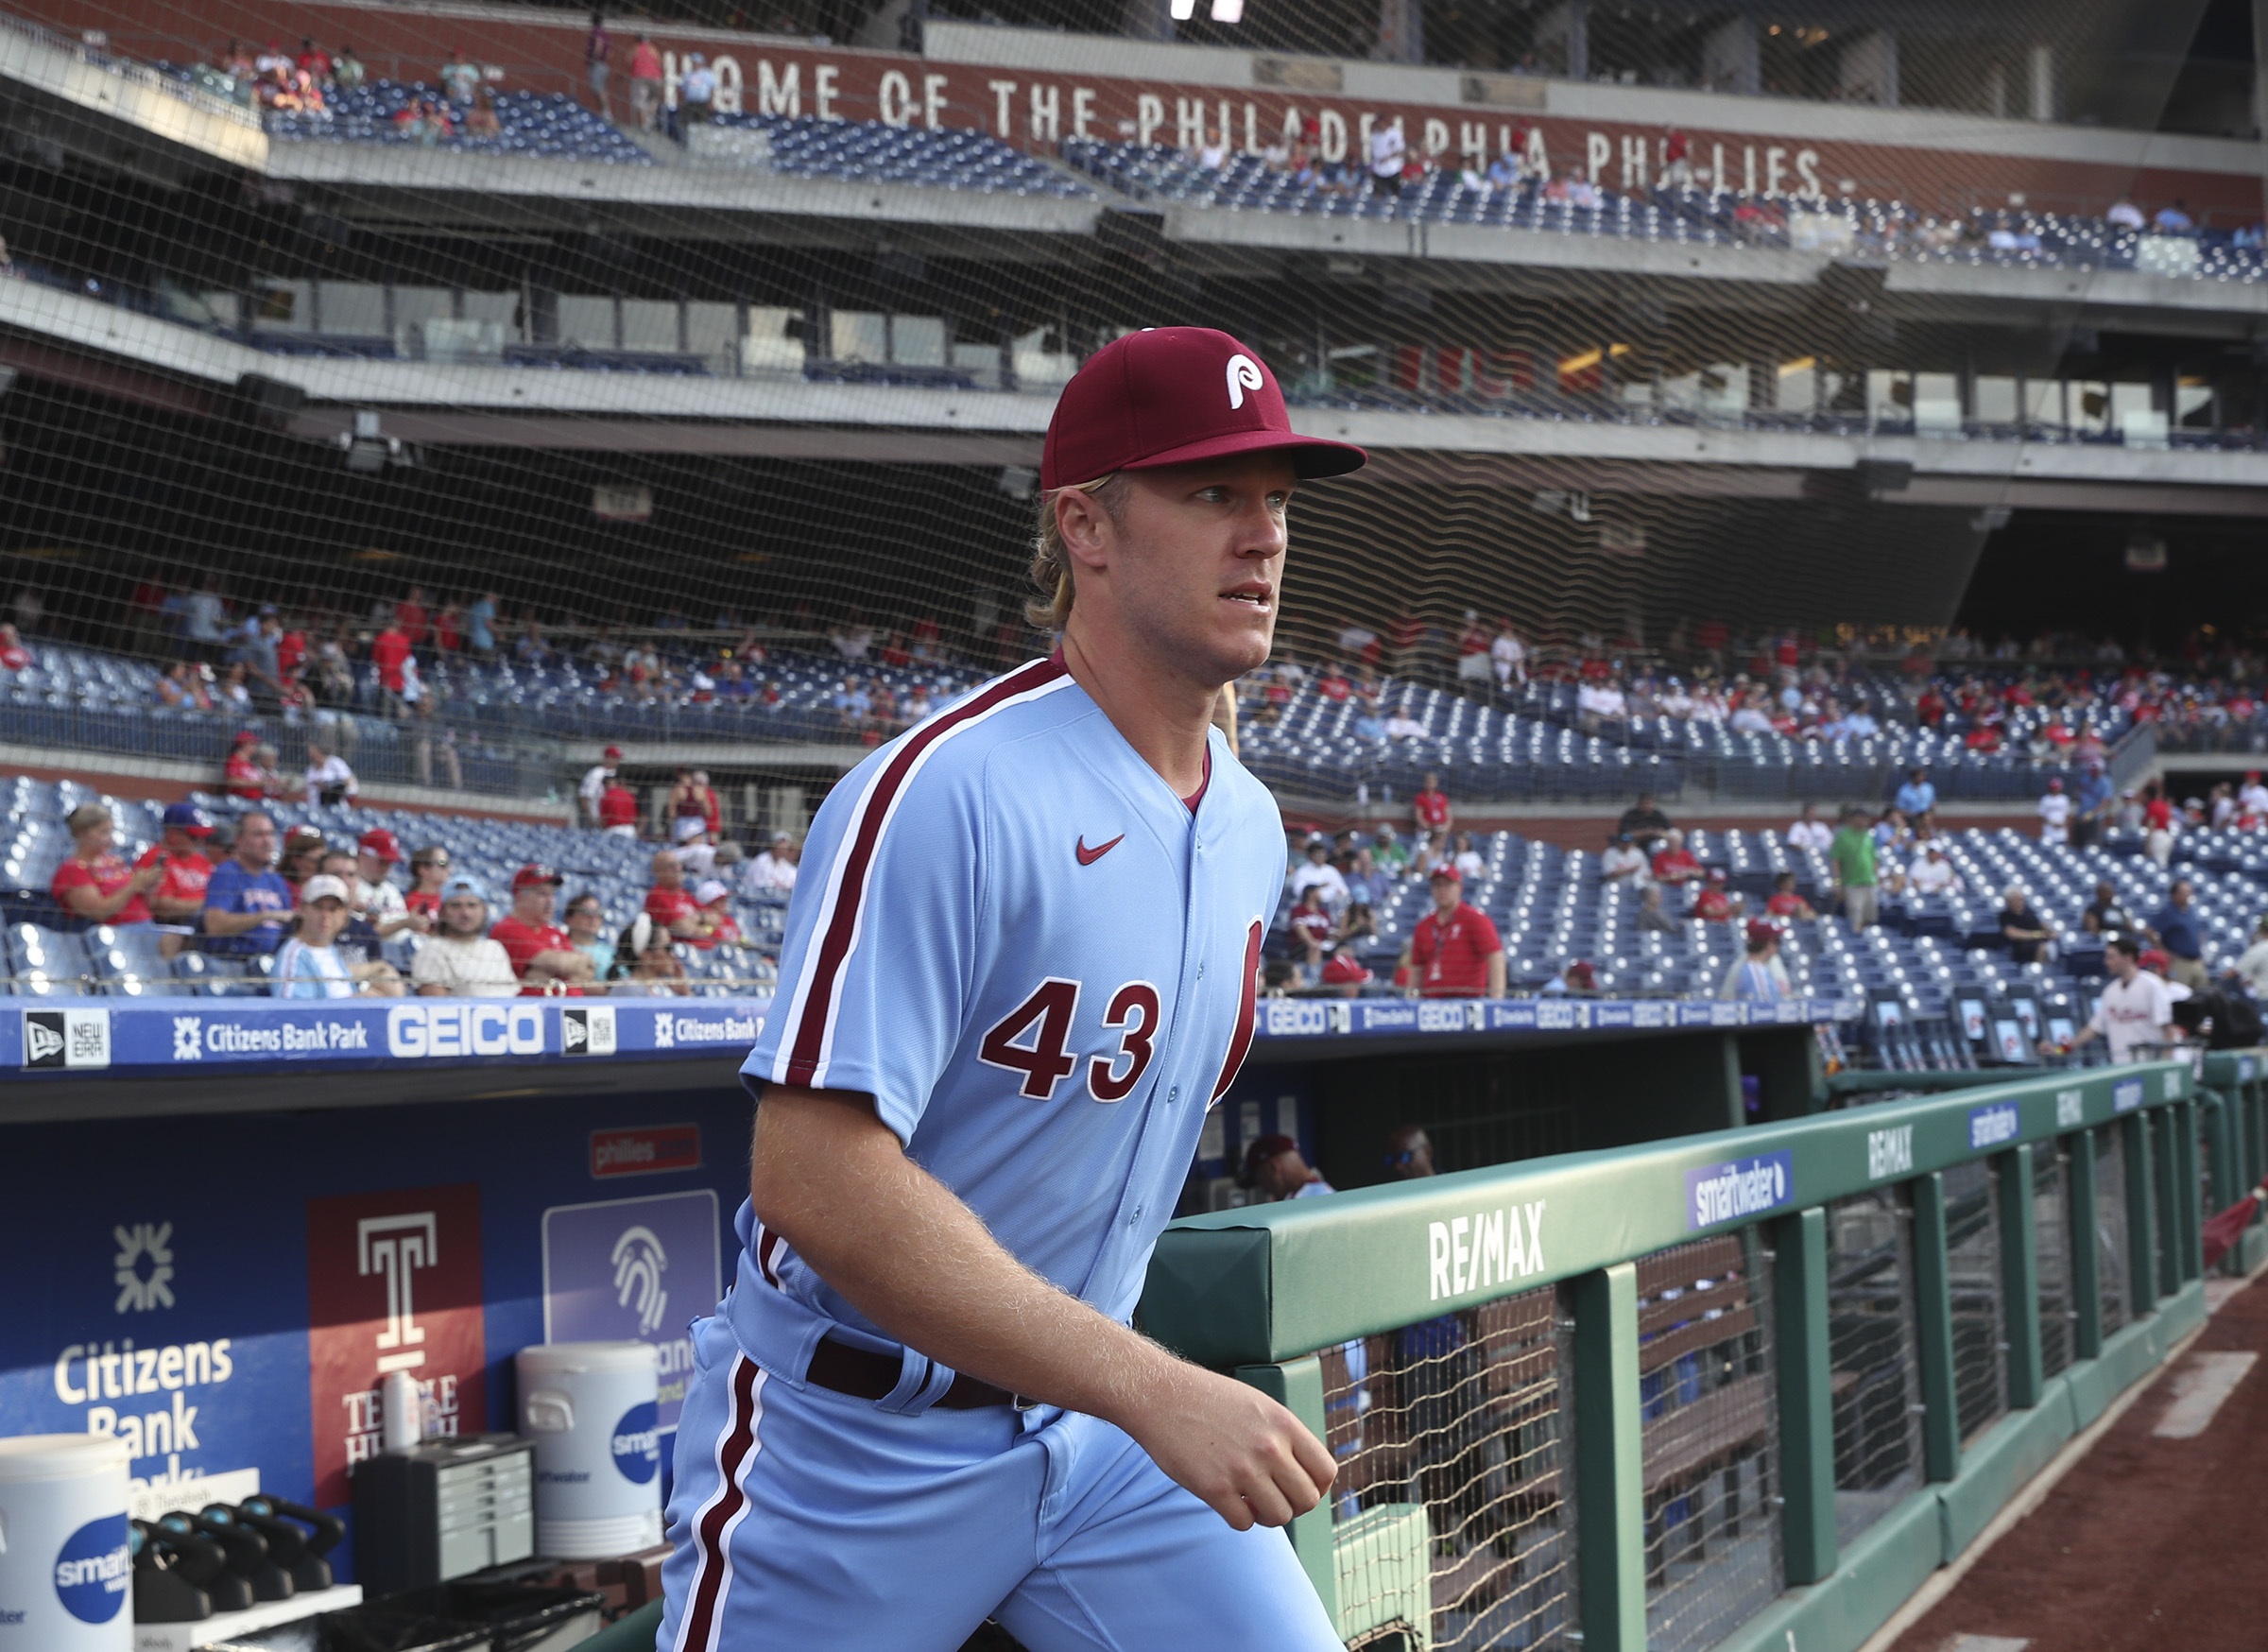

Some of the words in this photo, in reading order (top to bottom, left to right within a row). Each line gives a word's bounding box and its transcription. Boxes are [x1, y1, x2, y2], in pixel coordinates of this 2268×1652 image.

[663, 50, 840, 122] HOME
[878, 70, 949, 130] OF
[988, 79, 1096, 141] THE
[73, 1024, 103, 1039] NEW
[206, 1024, 282, 1052] Citizens
[283, 1021, 328, 1051] Bank
[329, 1020, 368, 1050] Park
[387, 1005, 544, 1058] GEICO
[676, 1019, 725, 1041] Citizens
[725, 1018, 756, 1040] Bank
[977, 976, 1161, 1104] 43
[1267, 1003, 1325, 1035] GEICO
[75, 1041, 103, 1058] ERA
[1695, 1160, 1774, 1227] smartwater
[1429, 1201, 1545, 1300] RE/MAX
[55, 1337, 233, 1404] Citizens
